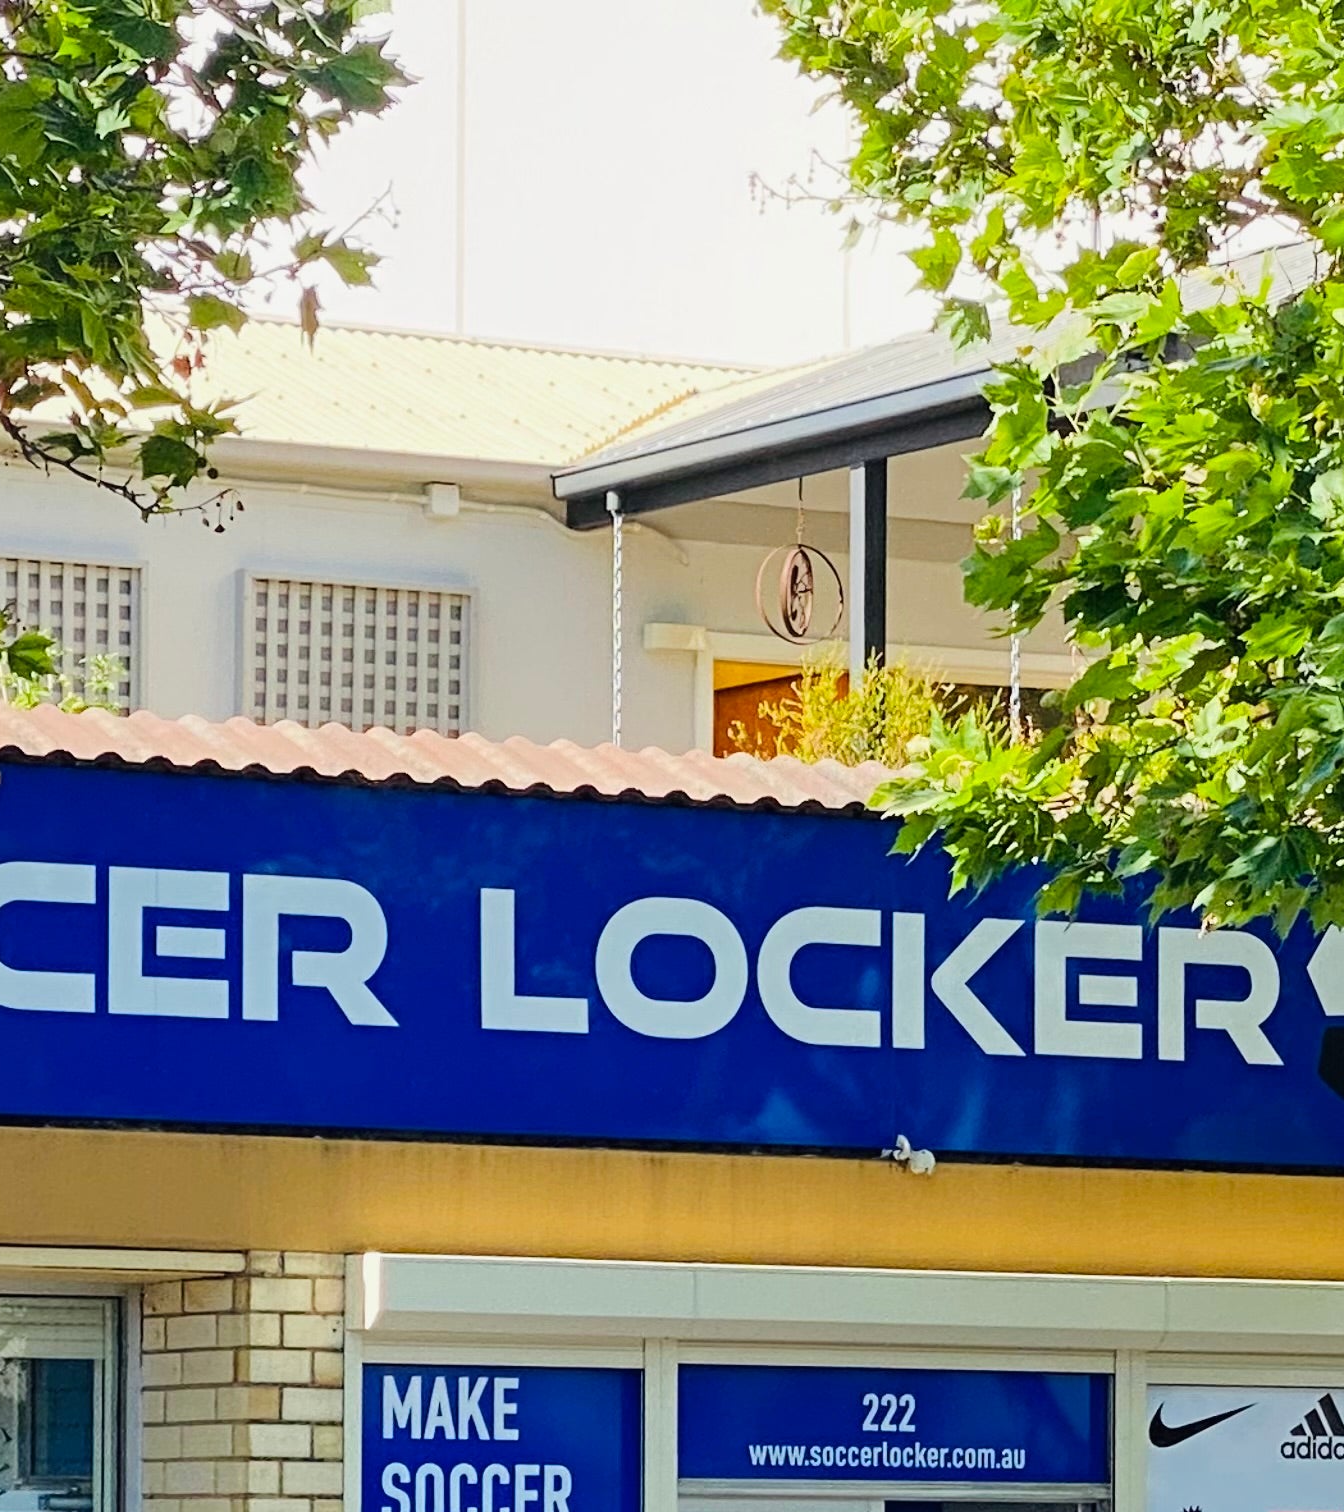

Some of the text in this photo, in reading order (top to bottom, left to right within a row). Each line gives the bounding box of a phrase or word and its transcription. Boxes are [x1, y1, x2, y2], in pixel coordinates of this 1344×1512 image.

[481, 887, 1284, 1065] LOCKER
[382, 1375, 520, 1440] MAKE
[862, 1393, 916, 1432] 222
[749, 1441, 1026, 1470] www.soccerlocker.com.au
